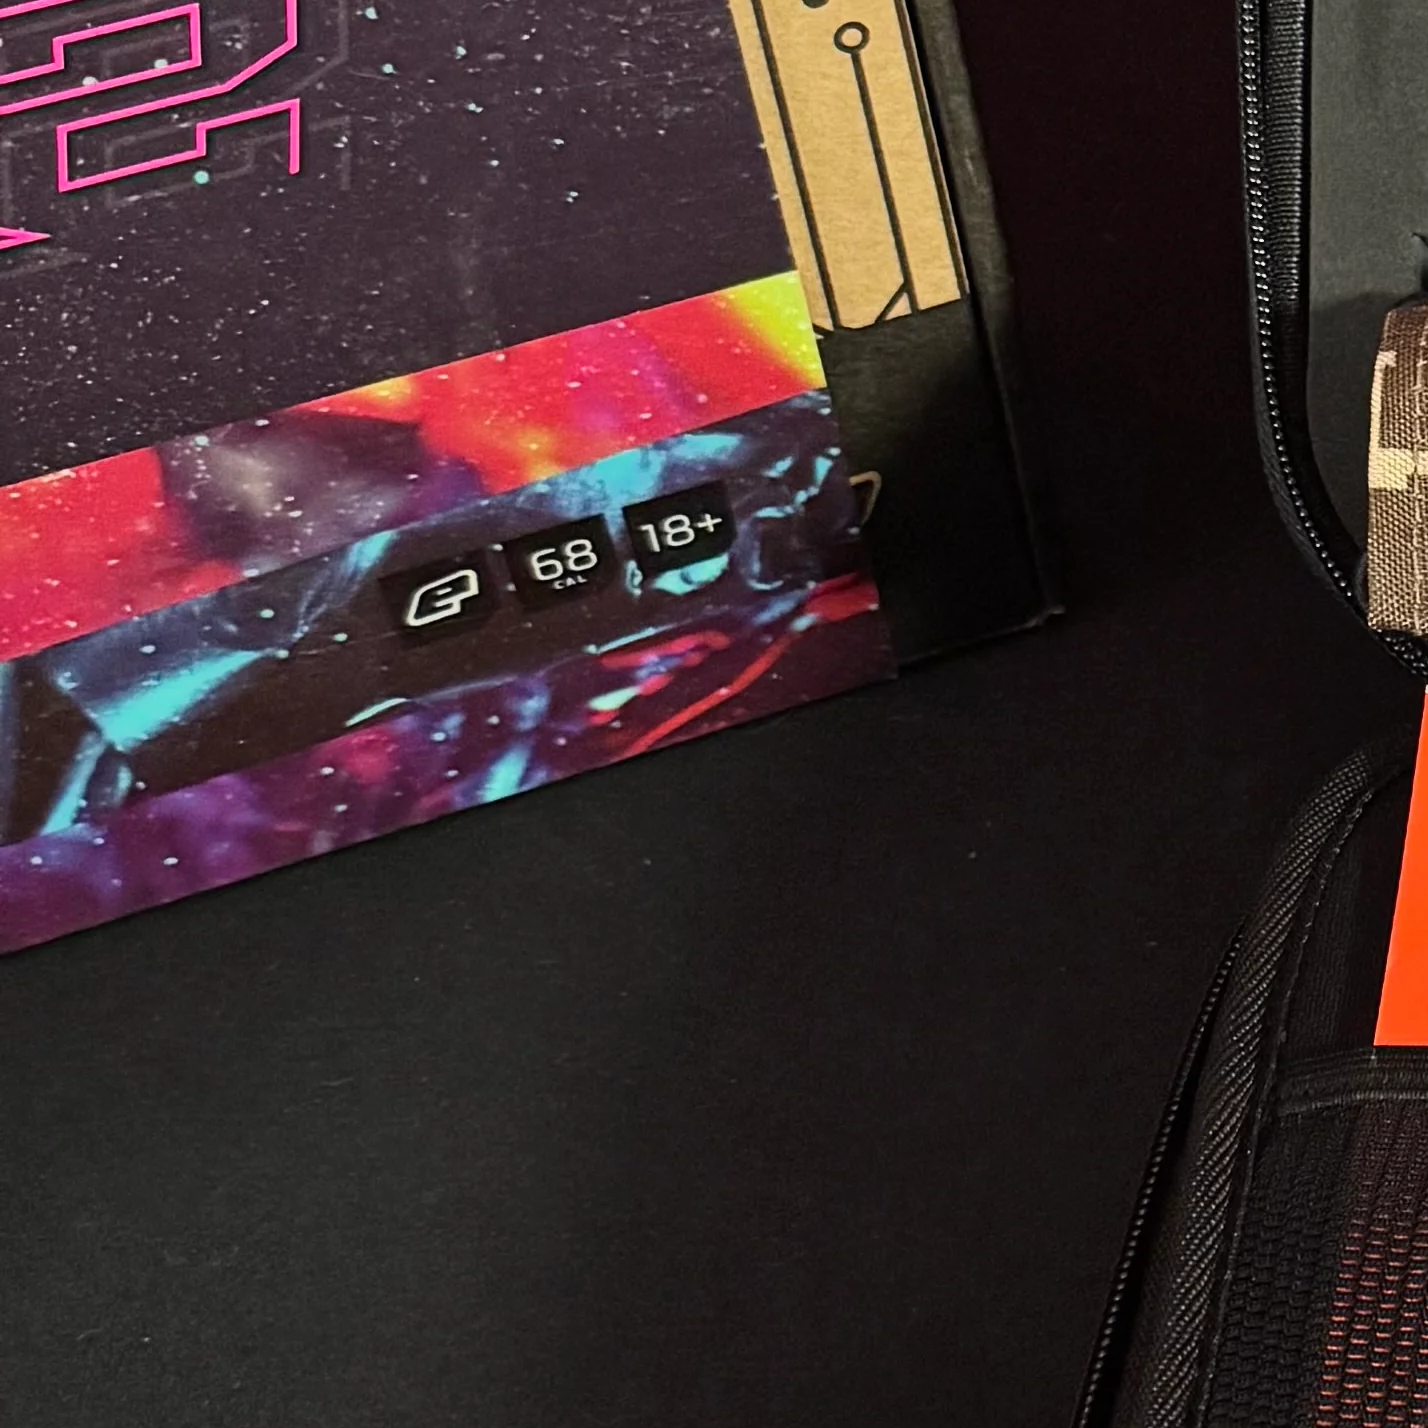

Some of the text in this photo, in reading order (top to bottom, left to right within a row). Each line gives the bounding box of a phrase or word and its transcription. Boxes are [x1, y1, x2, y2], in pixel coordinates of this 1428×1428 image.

[637, 513, 723, 553] 18+
[529, 538, 599, 581] 68
[553, 574, 588, 590] CAL
